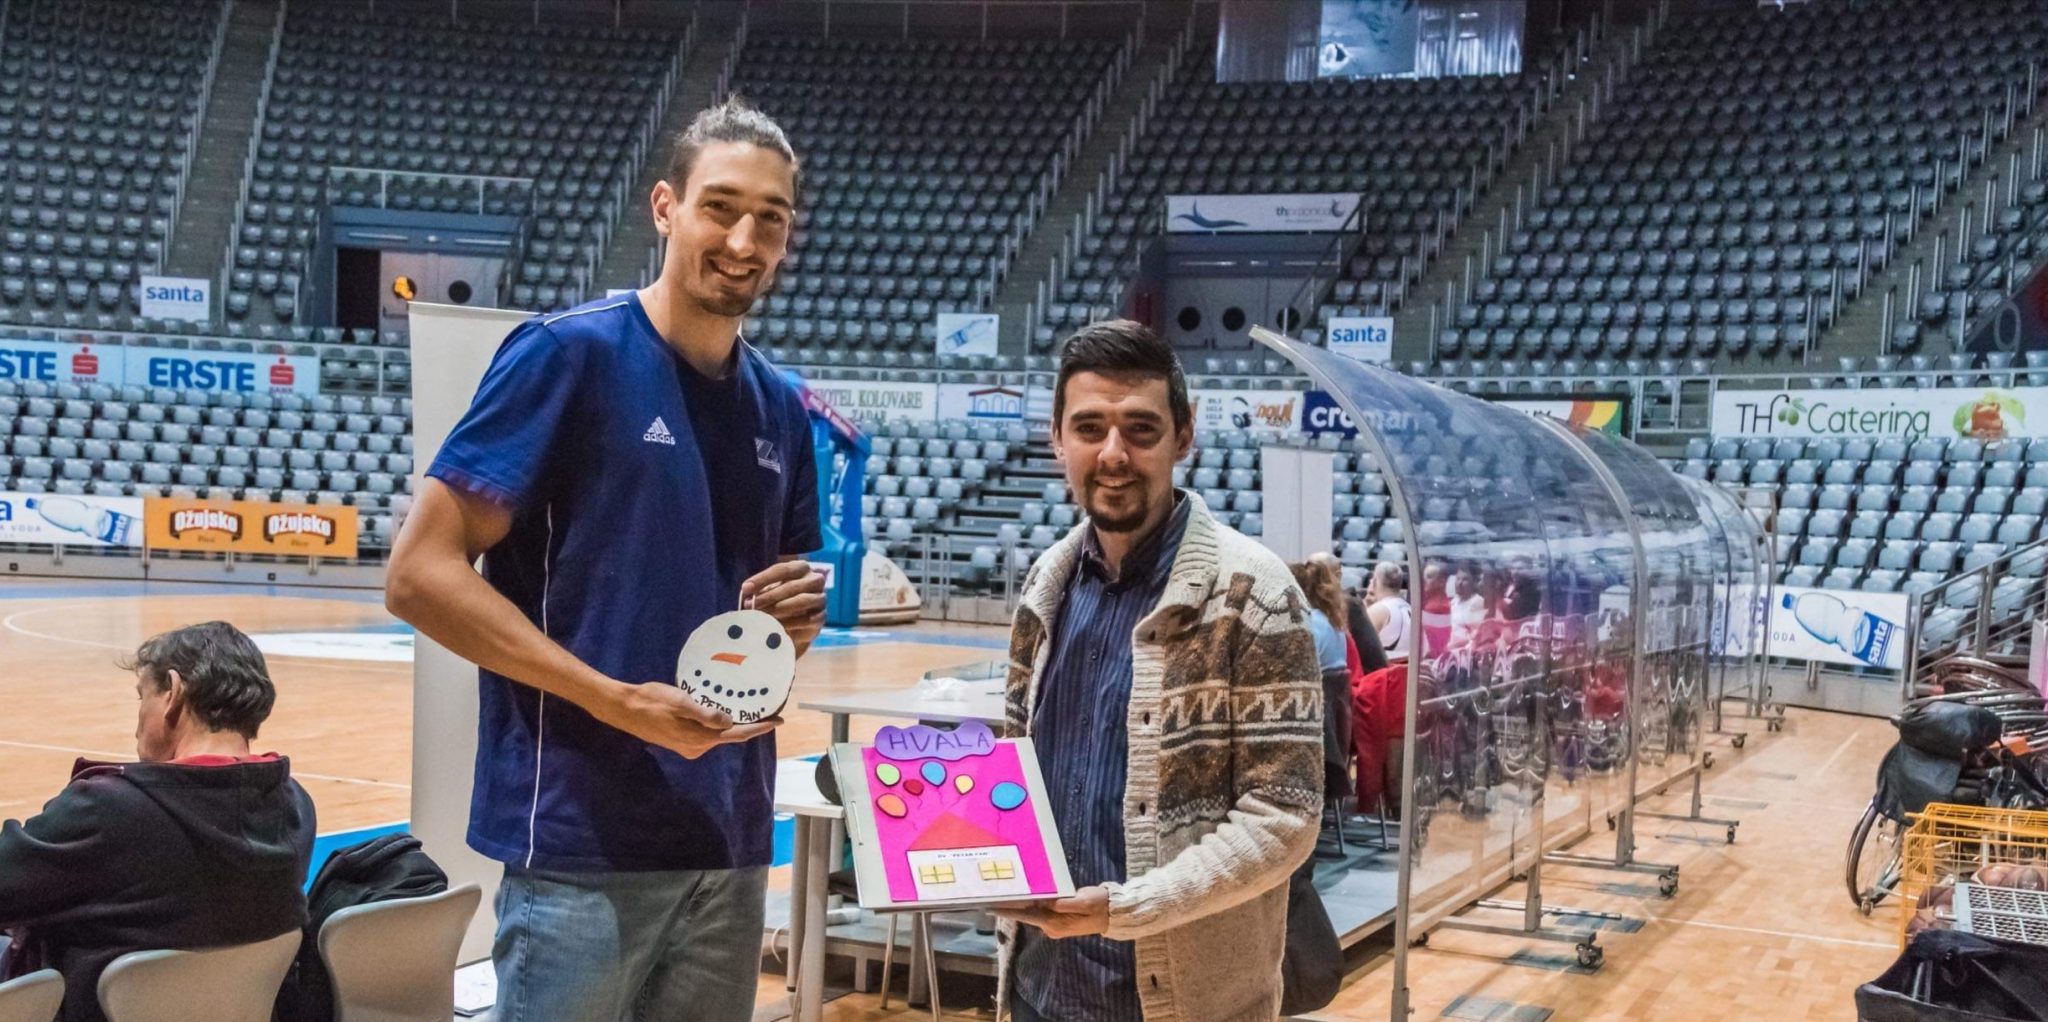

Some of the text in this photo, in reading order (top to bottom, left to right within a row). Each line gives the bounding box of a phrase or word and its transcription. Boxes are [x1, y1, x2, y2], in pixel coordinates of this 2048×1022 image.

[146, 285, 204, 302] santa
[1332, 325, 1387, 343] santa
[149, 357, 255, 391] ERSTE
[859, 390, 923, 409] KOLOVARE
[1807, 402, 1930, 439] Catering
[643, 432, 676, 445] adidas
[1773, 633, 1796, 643] ODA
[1867, 621, 1888, 664] santa
[680, 679, 697, 695] DV
[888, 731, 991, 752] HVALA
